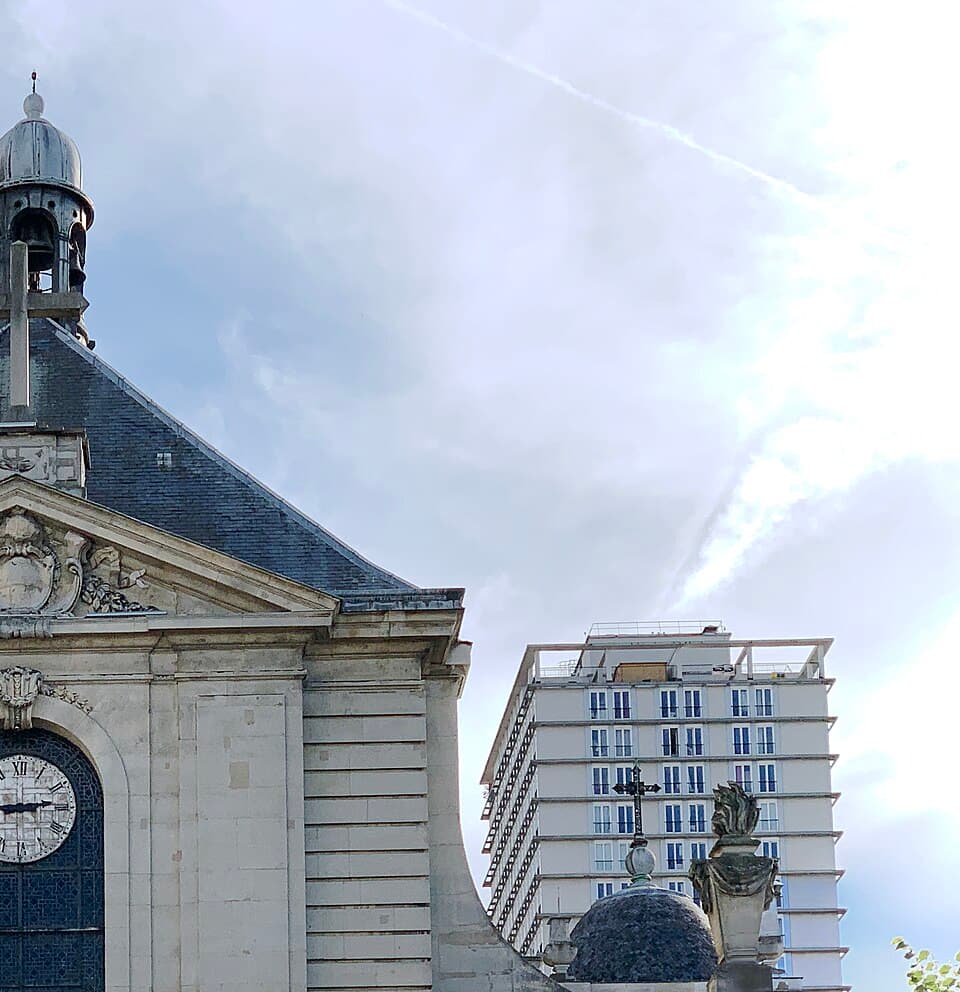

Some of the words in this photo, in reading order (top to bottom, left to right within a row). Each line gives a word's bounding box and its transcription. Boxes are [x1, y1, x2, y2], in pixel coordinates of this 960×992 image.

[12, 762, 27, 776] XII
[36, 767, 45, 779] I
[49, 782, 63, 793] II
